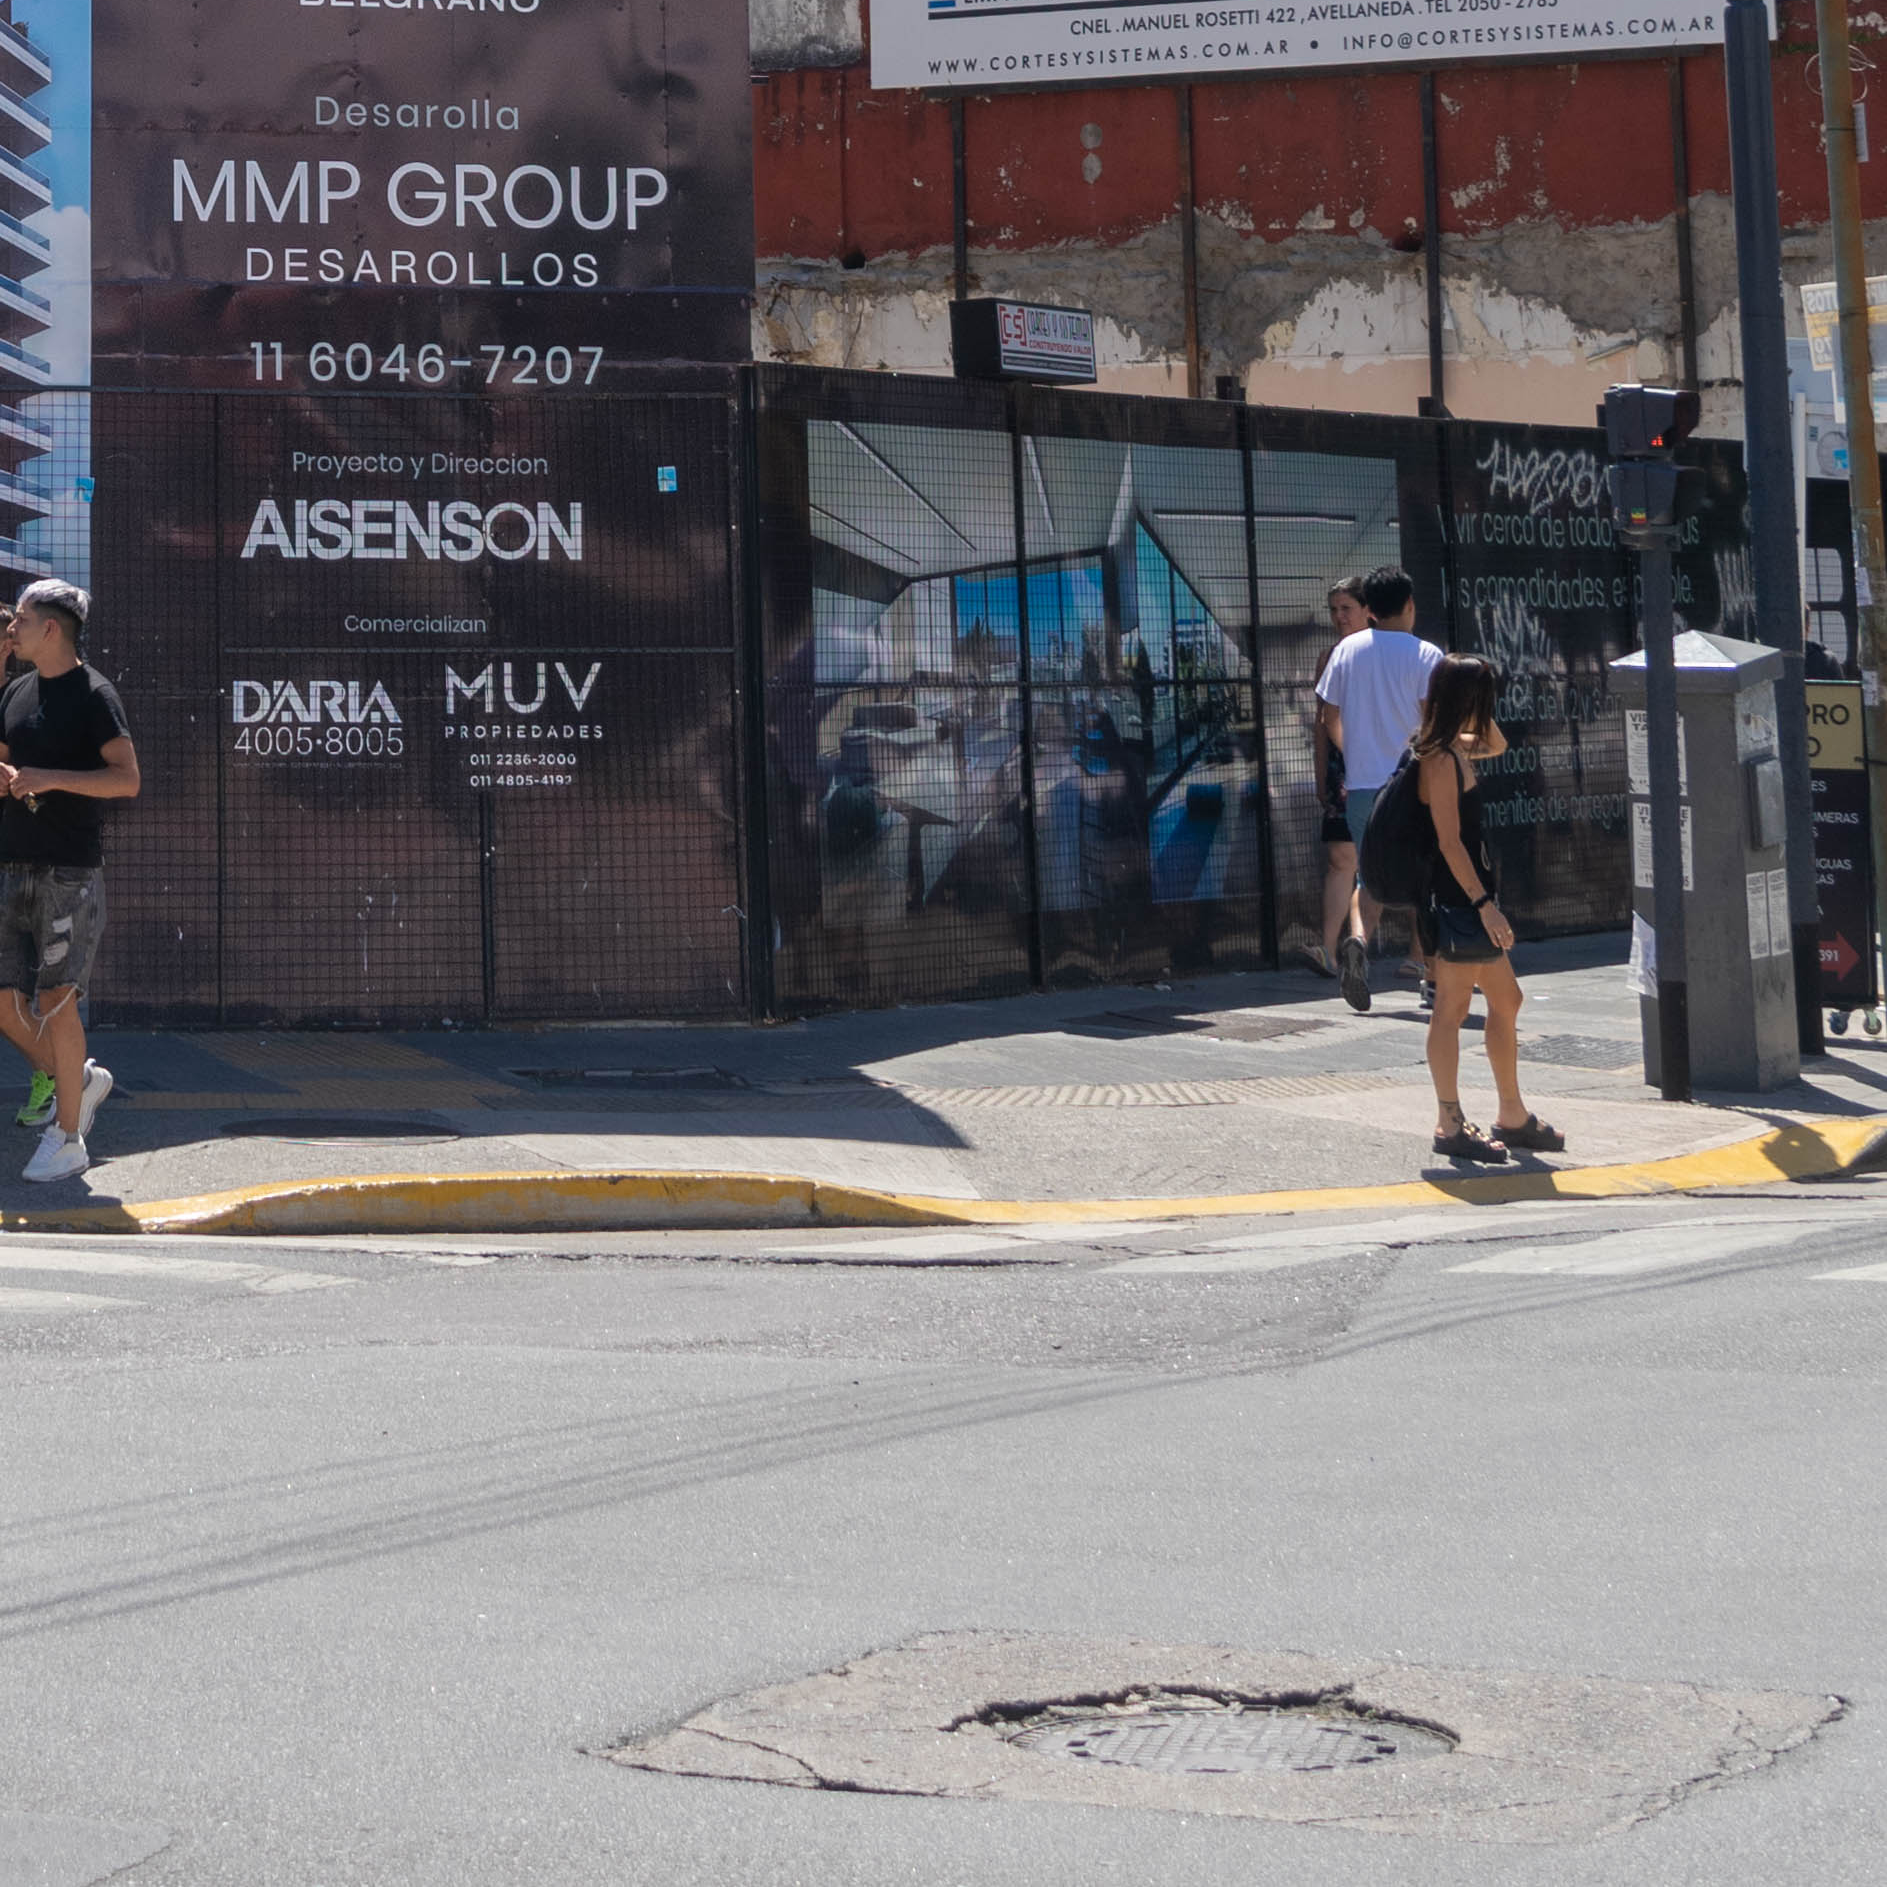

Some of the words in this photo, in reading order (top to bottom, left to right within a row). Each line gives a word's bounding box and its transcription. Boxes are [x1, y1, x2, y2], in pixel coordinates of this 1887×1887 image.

[1196, 9, 1260, 28] ROSETTI
[928, 39, 1289, 75] WWW.CORTESYSISTEMAS.COM.AR
[1343, 16, 1715, 51] INFO@CORTESYSISTEMAS.COM.AR
[315, 95, 519, 131] Desarolla
[172, 158, 361, 225] MMP
[386, 161, 668, 231] GROUP
[246, 247, 600, 288] DESAROLLOS
[249, 342, 284, 381] 11
[308, 341, 605, 386] 6046-7207
[293, 452, 403, 479] Proyecto
[411, 456, 424, 479] y
[432, 452, 549, 474] Direccion
[241, 498, 582, 562] AISENSON
[344, 614, 487, 633] Comercializan
[445, 662, 602, 715] MUV
[444, 725, 603, 740] PROPIEDADES
[470, 754, 490, 765] 011
[470, 776, 490, 786] 011
